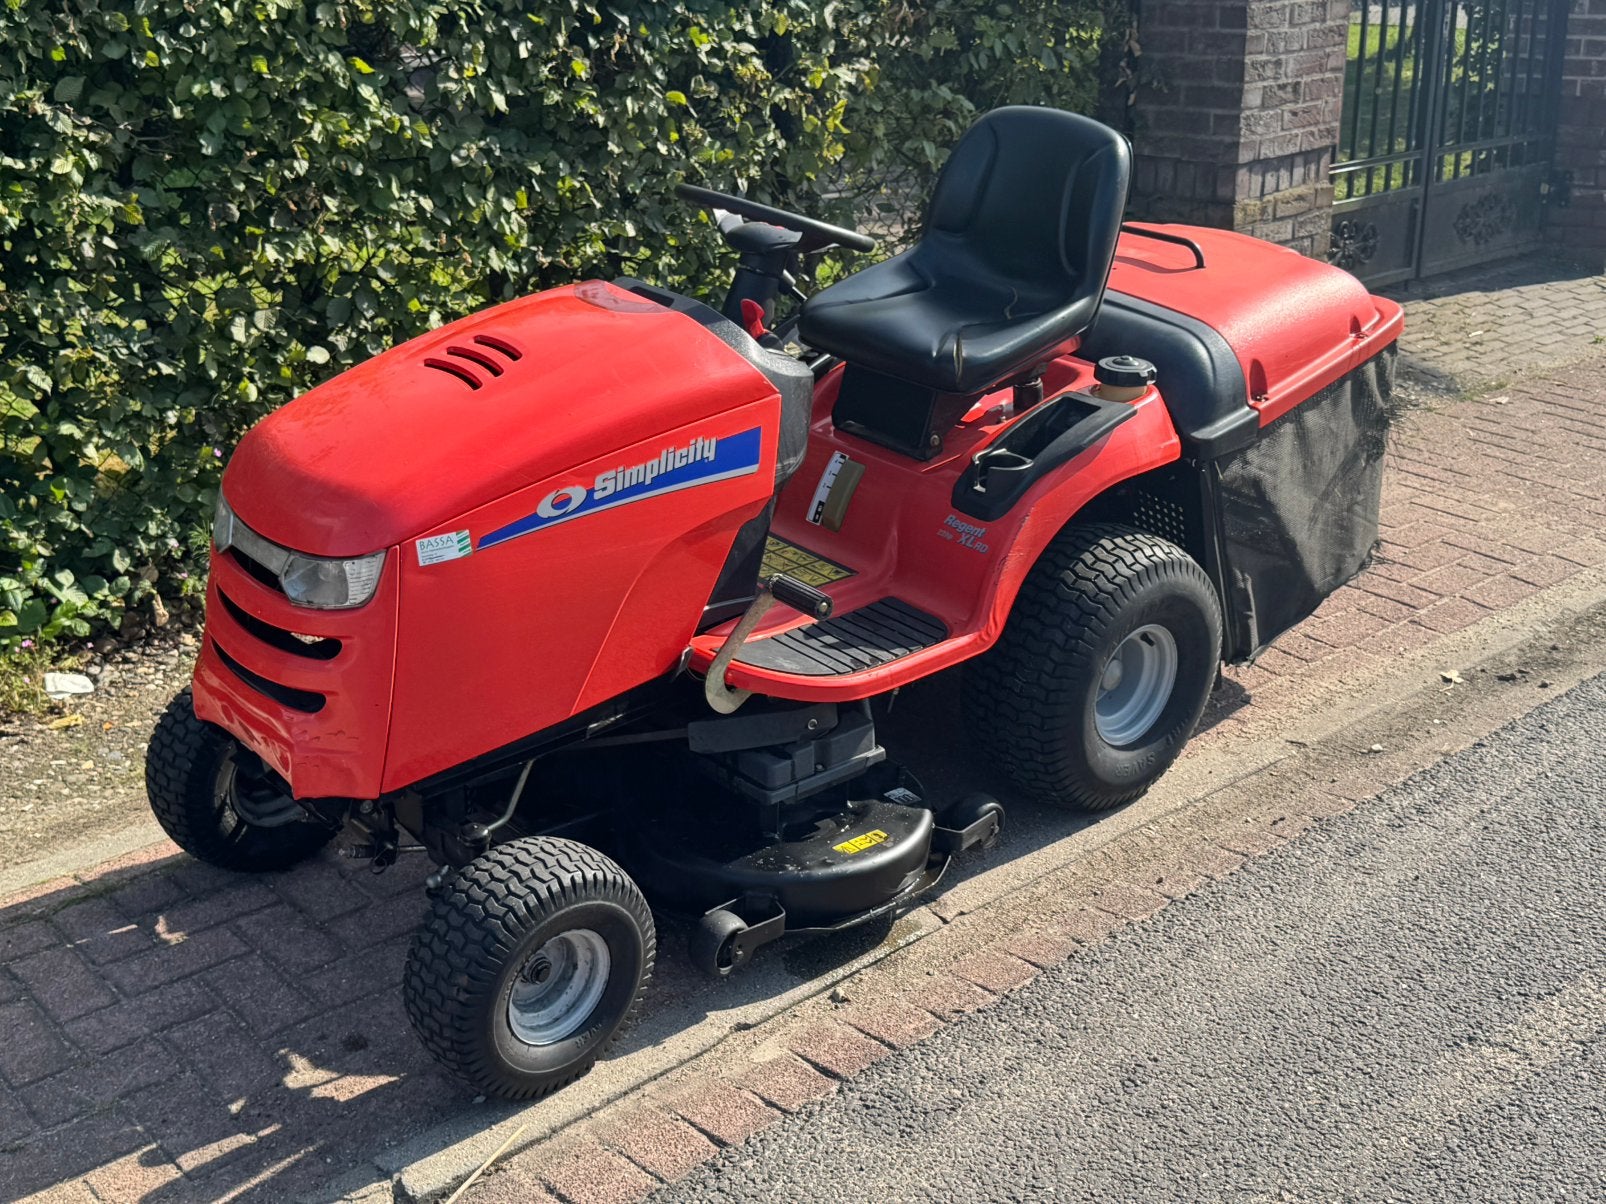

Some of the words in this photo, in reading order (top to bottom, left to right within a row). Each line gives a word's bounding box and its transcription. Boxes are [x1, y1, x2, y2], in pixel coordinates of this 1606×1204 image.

[593, 436, 717, 500] Simplicity
[944, 515, 986, 537] Regent
[419, 535, 454, 551] BASSA
